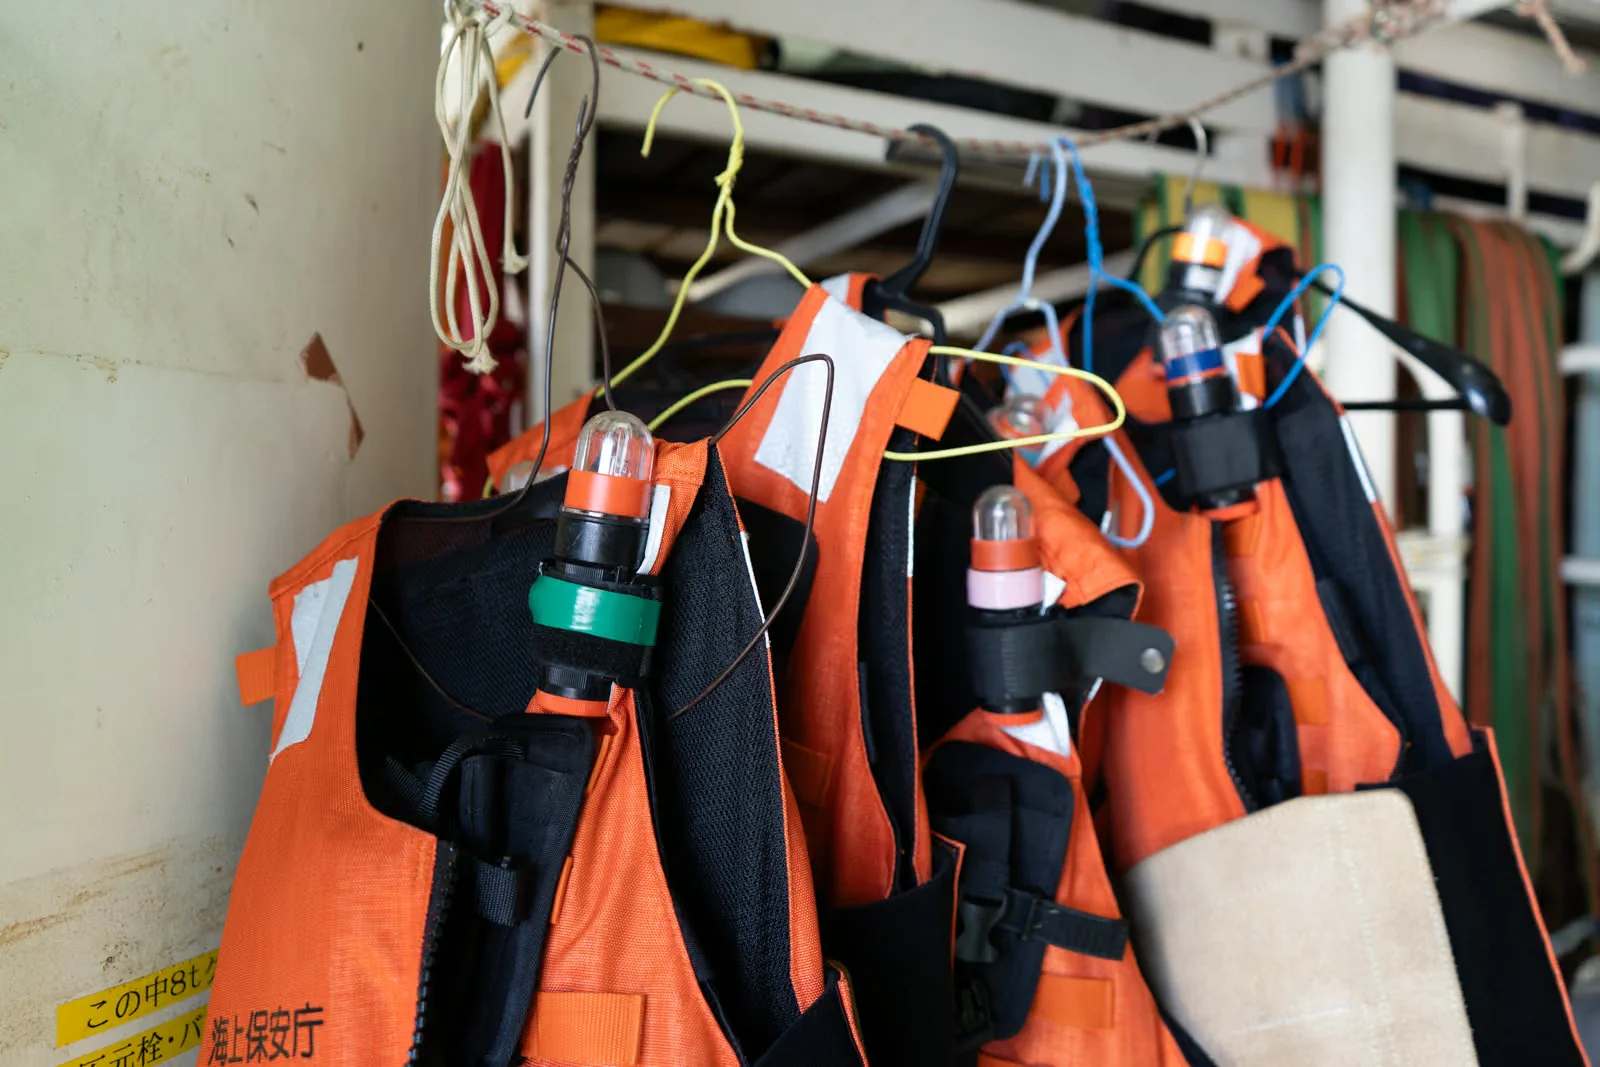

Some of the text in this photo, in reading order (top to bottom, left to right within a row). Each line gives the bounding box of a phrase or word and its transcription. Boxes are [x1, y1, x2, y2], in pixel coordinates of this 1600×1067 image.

[208, 1002, 324, 1066] 海上保安庁
